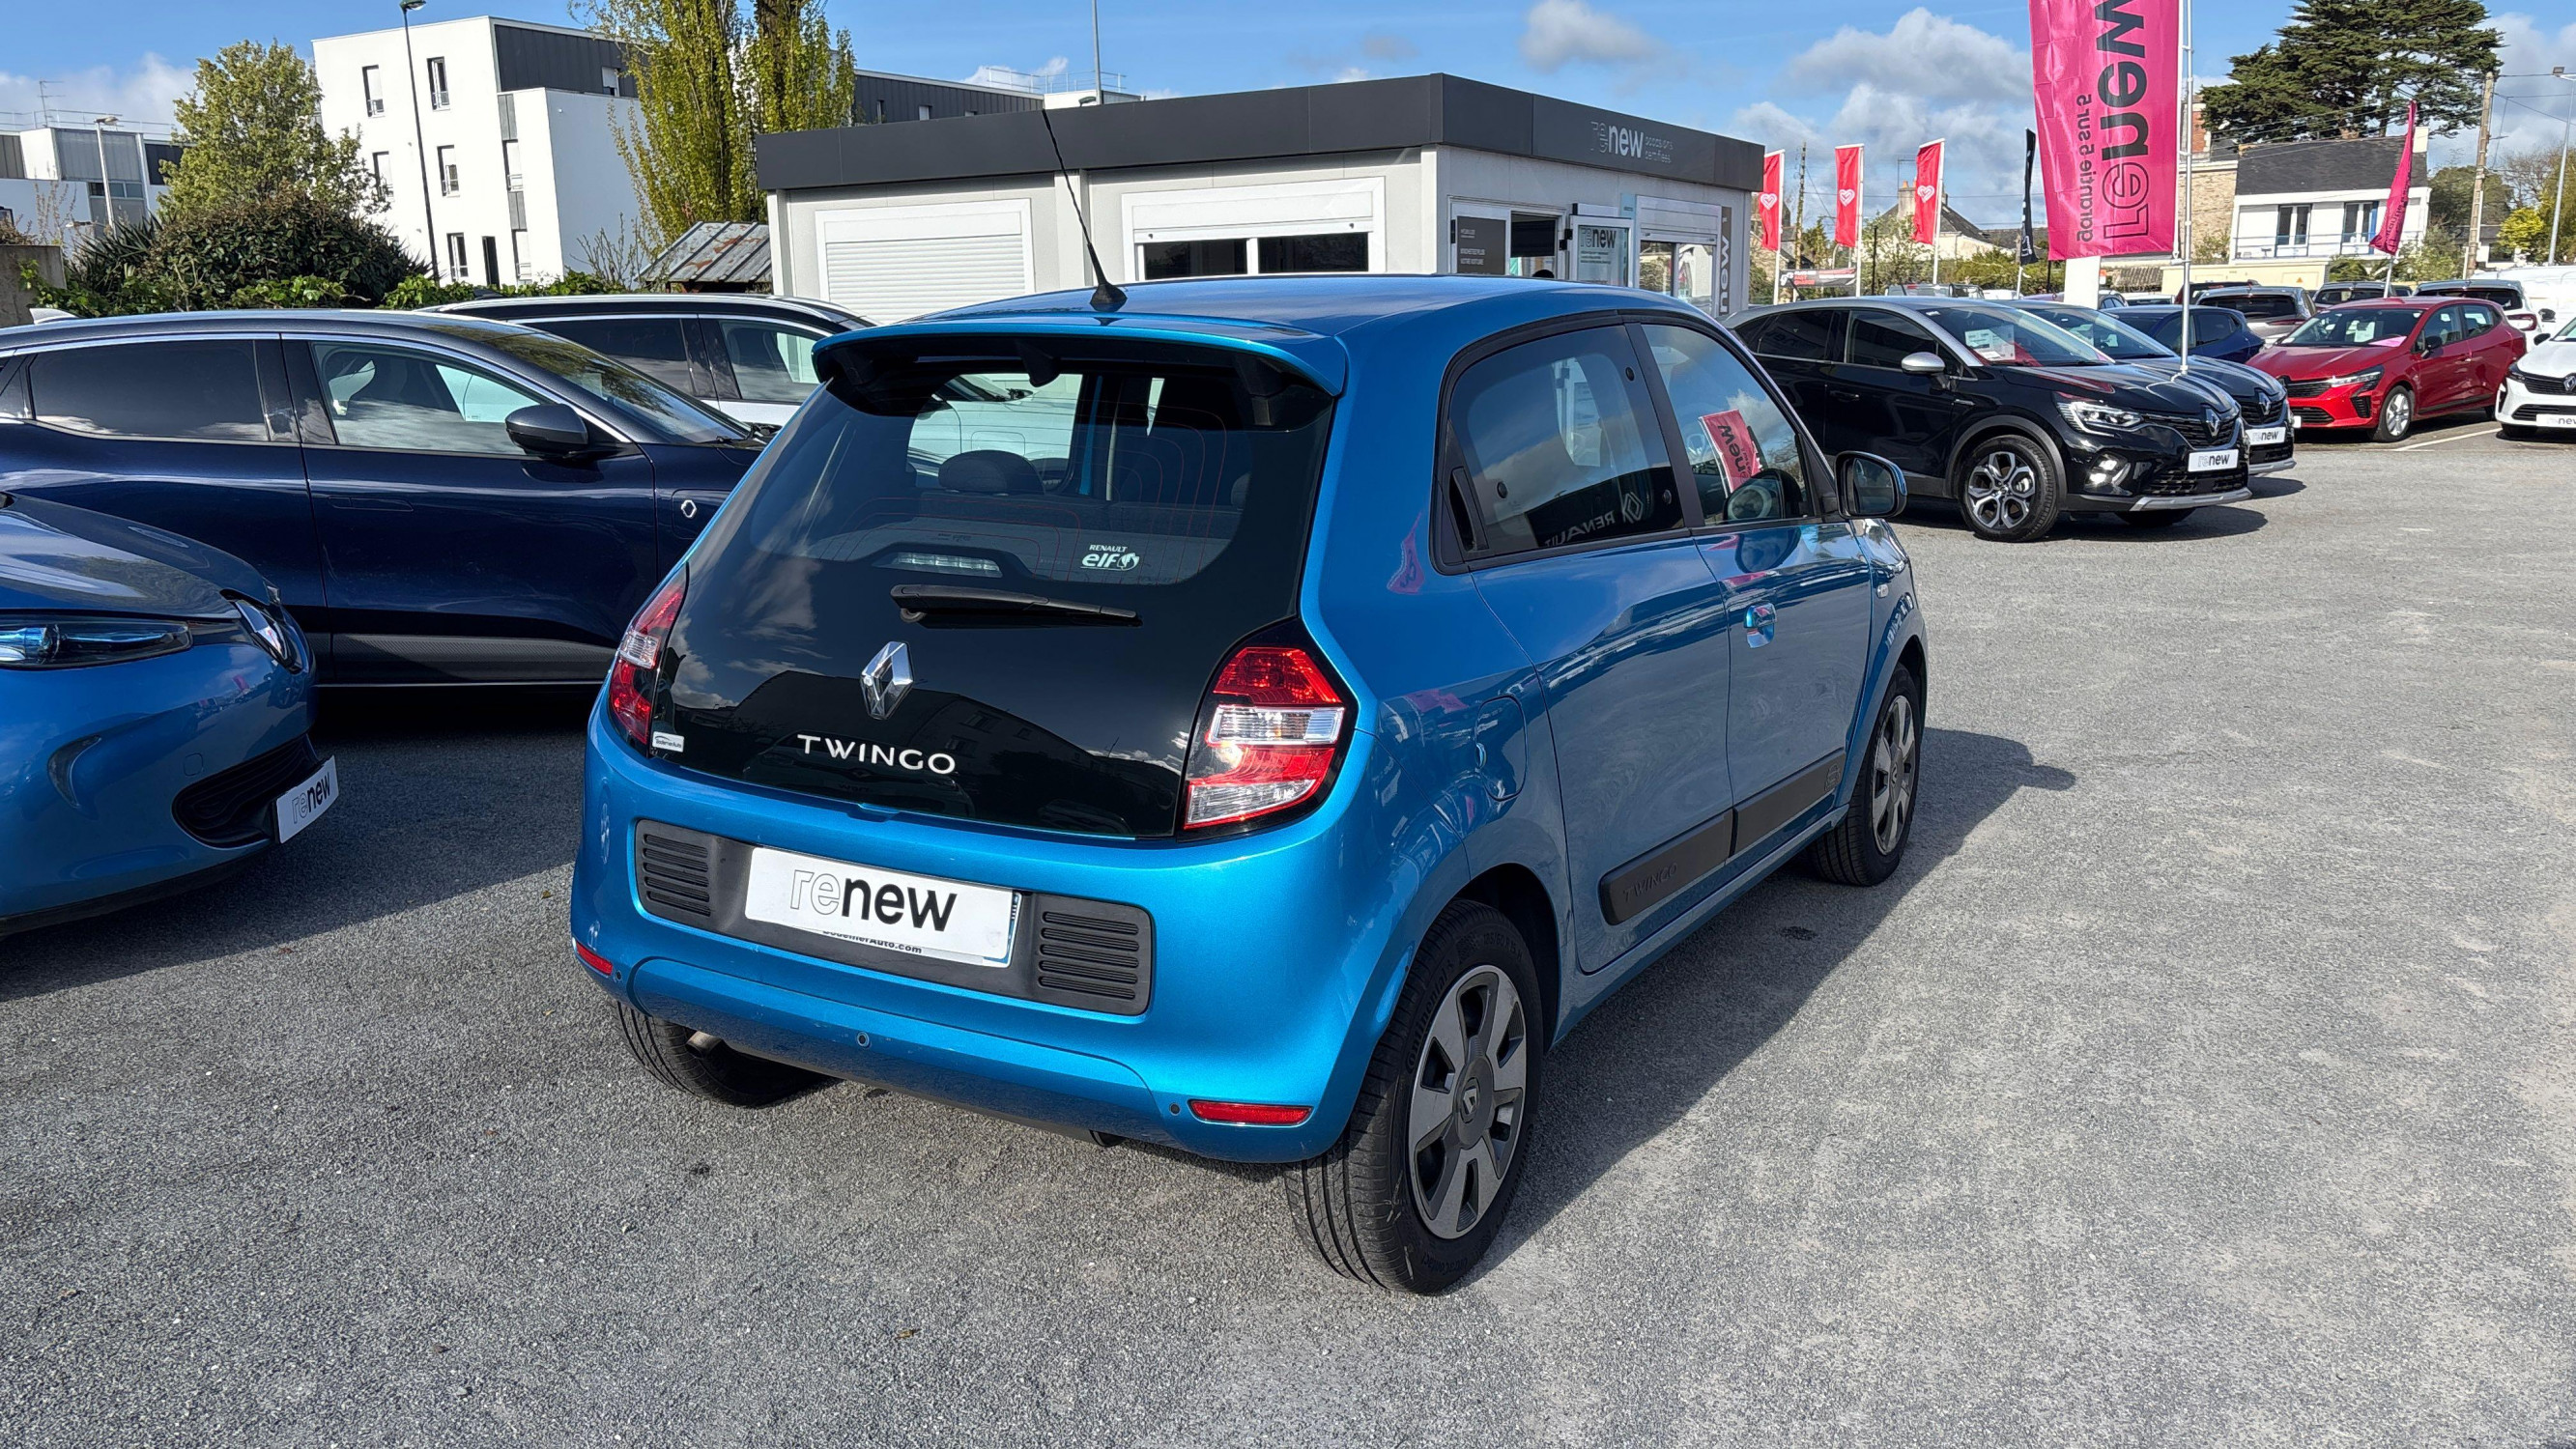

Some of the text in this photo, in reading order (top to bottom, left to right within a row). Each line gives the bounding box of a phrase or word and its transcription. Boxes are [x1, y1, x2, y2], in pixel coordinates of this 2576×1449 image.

[1081, 553, 1121, 568] elf
[1089, 544, 1129, 553] RENAULT
[797, 733, 957, 774] TWINGO
[291, 772, 330, 825] renew
[788, 869, 958, 932] renew
[1623, 862, 1678, 903] TWINGO
